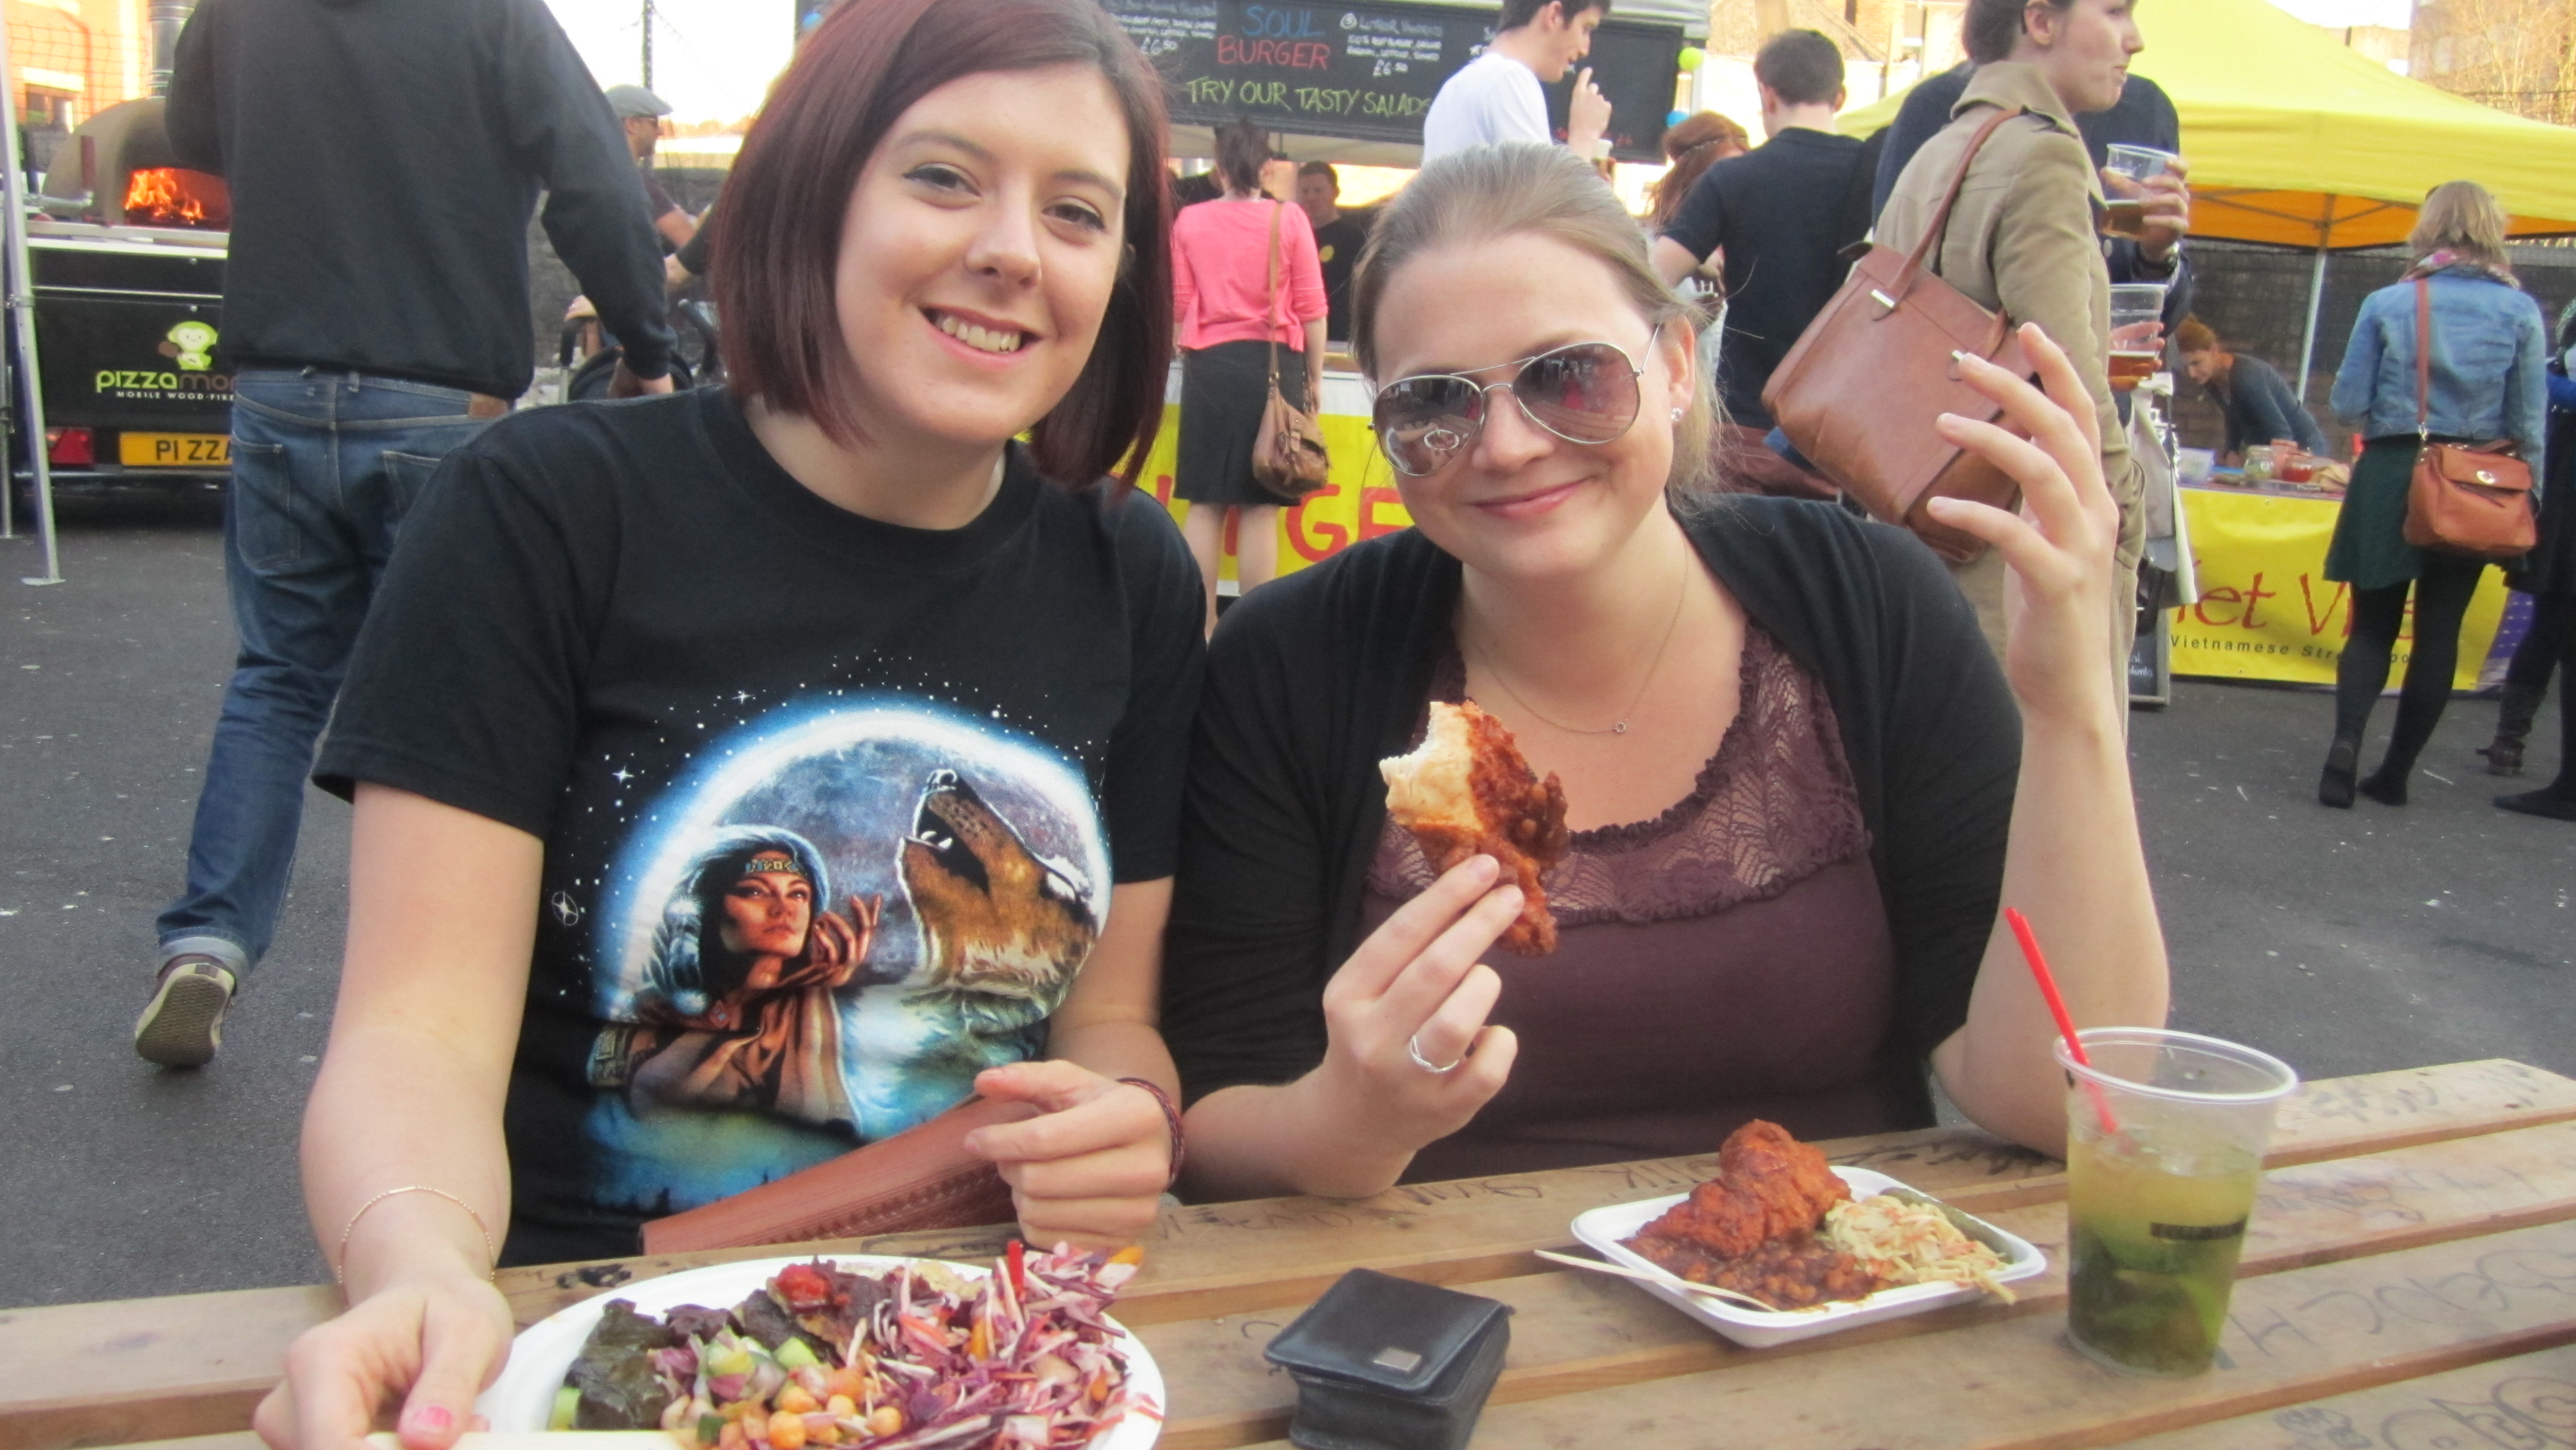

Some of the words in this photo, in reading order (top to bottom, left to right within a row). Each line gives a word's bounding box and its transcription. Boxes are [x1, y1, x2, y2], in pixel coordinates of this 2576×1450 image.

[1243, 6, 1326, 37] SOUL
[1217, 35, 1331, 70] BURGER
[1186, 76, 1234, 104] TRY
[1240, 81, 1292, 112] OUR
[1295, 87, 1360, 115] TASTY
[117, 391, 161, 399] MOBILE
[2171, 634, 2290, 655] Vietnamese
